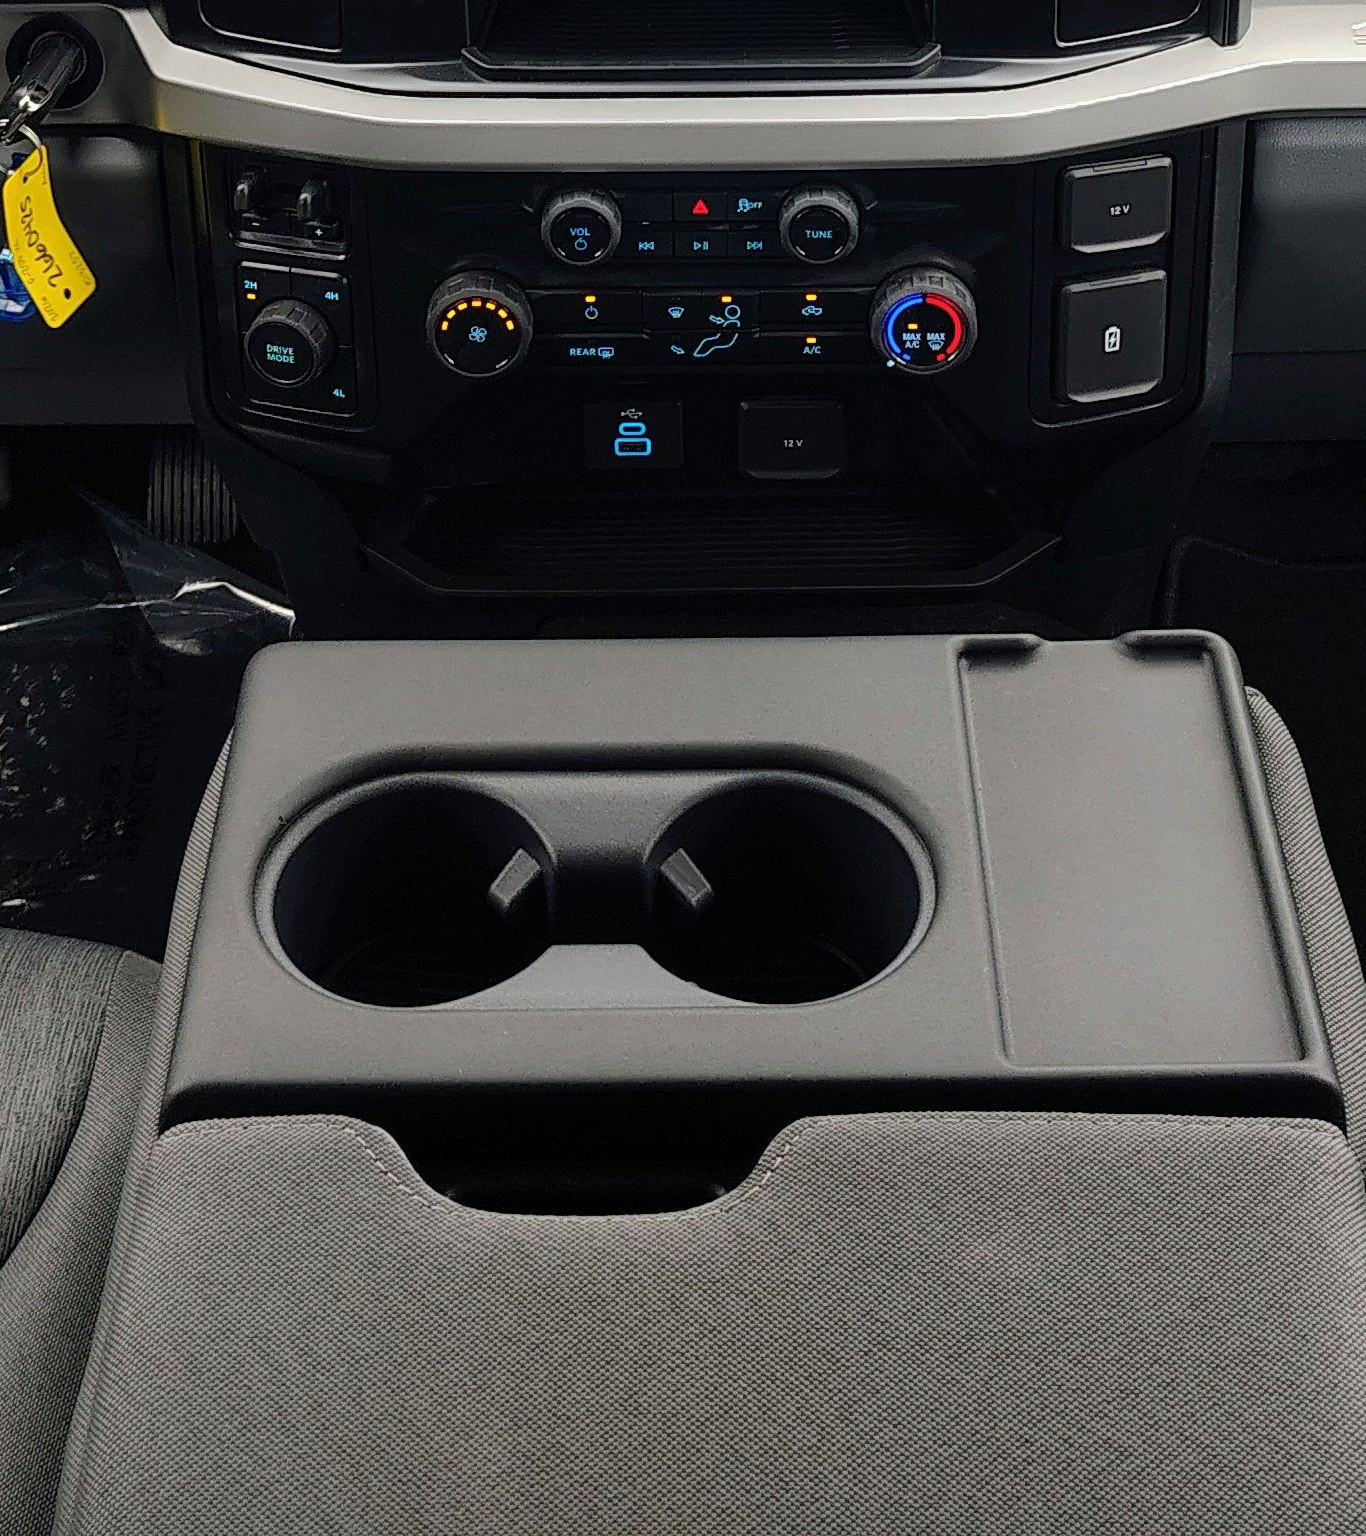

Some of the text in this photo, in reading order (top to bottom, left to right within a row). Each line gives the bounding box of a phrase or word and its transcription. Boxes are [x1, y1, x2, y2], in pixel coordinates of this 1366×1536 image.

[1110, 204, 1121, 216] 12
[569, 227, 591, 237] VOL
[804, 229, 834, 239] TUNE
[243, 279, 258, 290] 2H
[324, 291, 340, 301] 4H
[902, 332, 922, 341] MAX
[926, 332, 946, 341] MAX
[266, 343, 294, 355] DRIVE
[904, 340, 921, 349] A/C
[569, 347, 597, 357] REAR
[801, 345, 822, 355] A/C
[266, 353, 295, 364] MODE
[332, 388, 346, 399] 4L
[783, 438, 794, 449] 12
